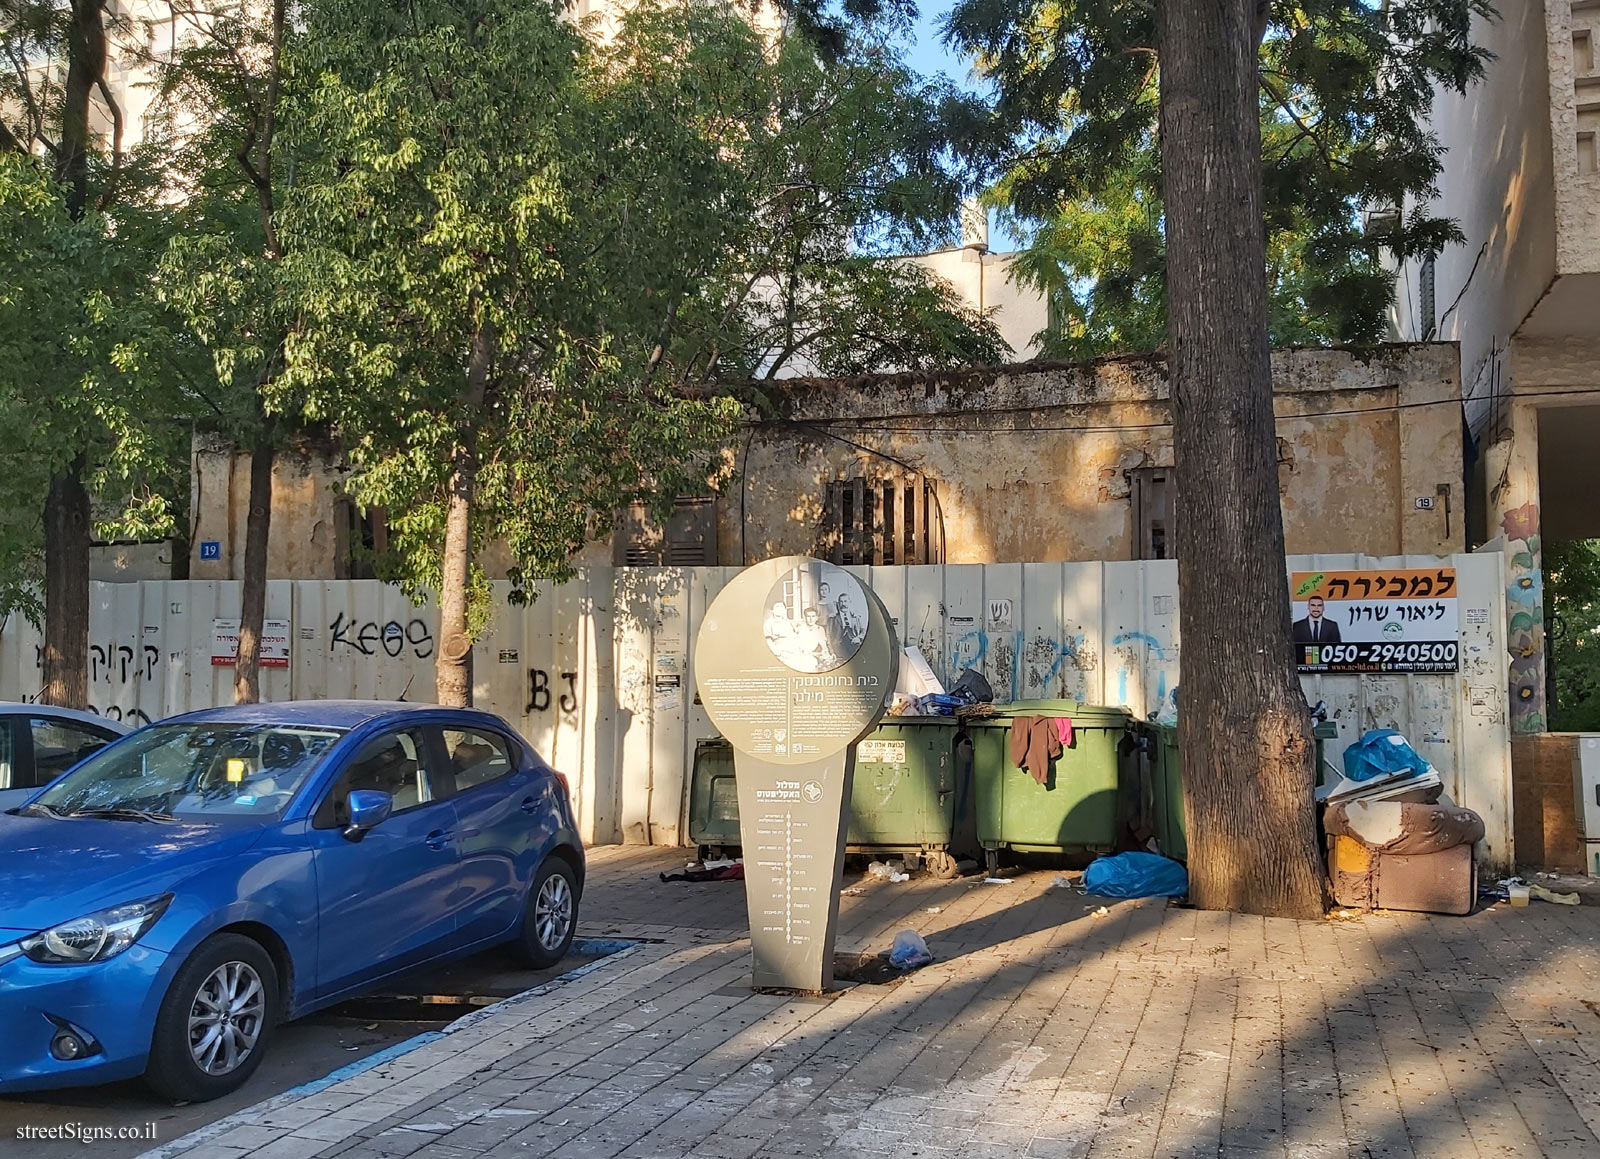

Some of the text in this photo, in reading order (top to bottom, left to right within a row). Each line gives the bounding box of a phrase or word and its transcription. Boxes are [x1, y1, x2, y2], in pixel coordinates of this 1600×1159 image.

[1418, 498, 1430, 507] 19
[204, 545, 217, 556] 19
[1328, 570, 1455, 598] למכירה
[1348, 605, 1389, 626] שרון
[1397, 602, 1446, 622] ליאור
[1320, 643, 1457, 663] 050-2940500
[792, 676, 853, 689] נחומובסקי
[856, 676, 879, 686] בית
[792, 689, 824, 702] מילנר
[776, 780, 800, 789] מסלול
[756, 789, 800, 799] האקליפטוס
